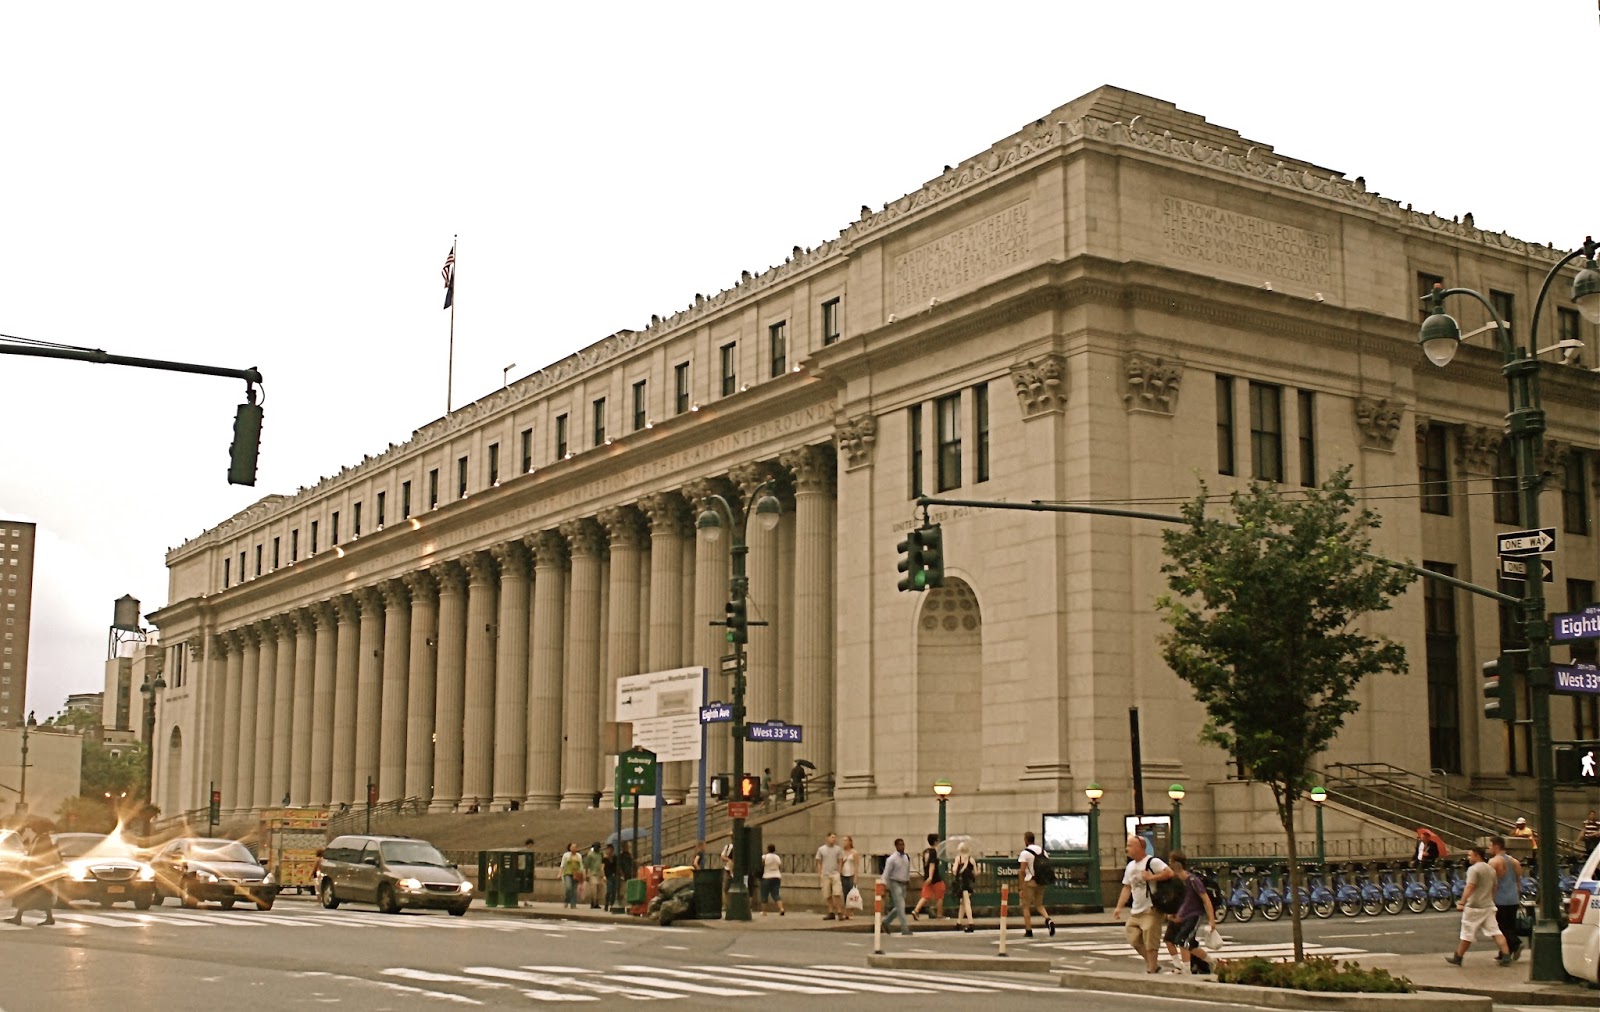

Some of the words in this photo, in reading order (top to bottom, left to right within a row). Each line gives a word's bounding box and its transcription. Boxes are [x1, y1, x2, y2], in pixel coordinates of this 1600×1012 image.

[1163, 197, 1183, 214] SIR
[1187, 204, 1244, 229] ROWLAND
[1247, 218, 1274, 237] HILL
[1276, 225, 1327, 250] FOUNDED
[1163, 212, 1187, 230] THE
[1191, 219, 1231, 238] PENNY
[1234, 228, 1260, 248] POST
[896, 239, 947, 271] CARDINAL
[951, 231, 964, 248] DE
[968, 204, 1028, 241] RICHELIEU
[1163, 227, 1210, 249] HEINRICH
[1213, 238, 1234, 253] VON
[1236, 243, 1279, 263] STEPHAN
[896, 258, 934, 286] PUBLIC
[939, 239, 978, 268] POSTAL
[983, 219, 1028, 248] SERVICE
[1171, 241, 1211, 261] POSTAL
[1215, 251, 1251, 270] UNION
[954, 266, 977, 286] DES
[982, 246, 1025, 275] POSTES
[633, 466, 647, 483] OF
[652, 449, 688, 474] THEIR
[694, 421, 769, 457] APPOINTED
[774, 399, 835, 432] ROUNDS
[892, 519, 918, 532] UNITED
[1505, 539, 1522, 550] ONE
[1529, 536, 1547, 547] WAY
[1508, 562, 1524, 573] ONE
[1558, 671, 1584, 688] West
[701, 708, 719, 722] Eighth
[719, 708, 730, 719] Ave
[752, 727, 773, 738] West
[789, 729, 799, 739] St
[627, 756, 652, 766] Subway
[997, 866, 1020, 876] Subw
